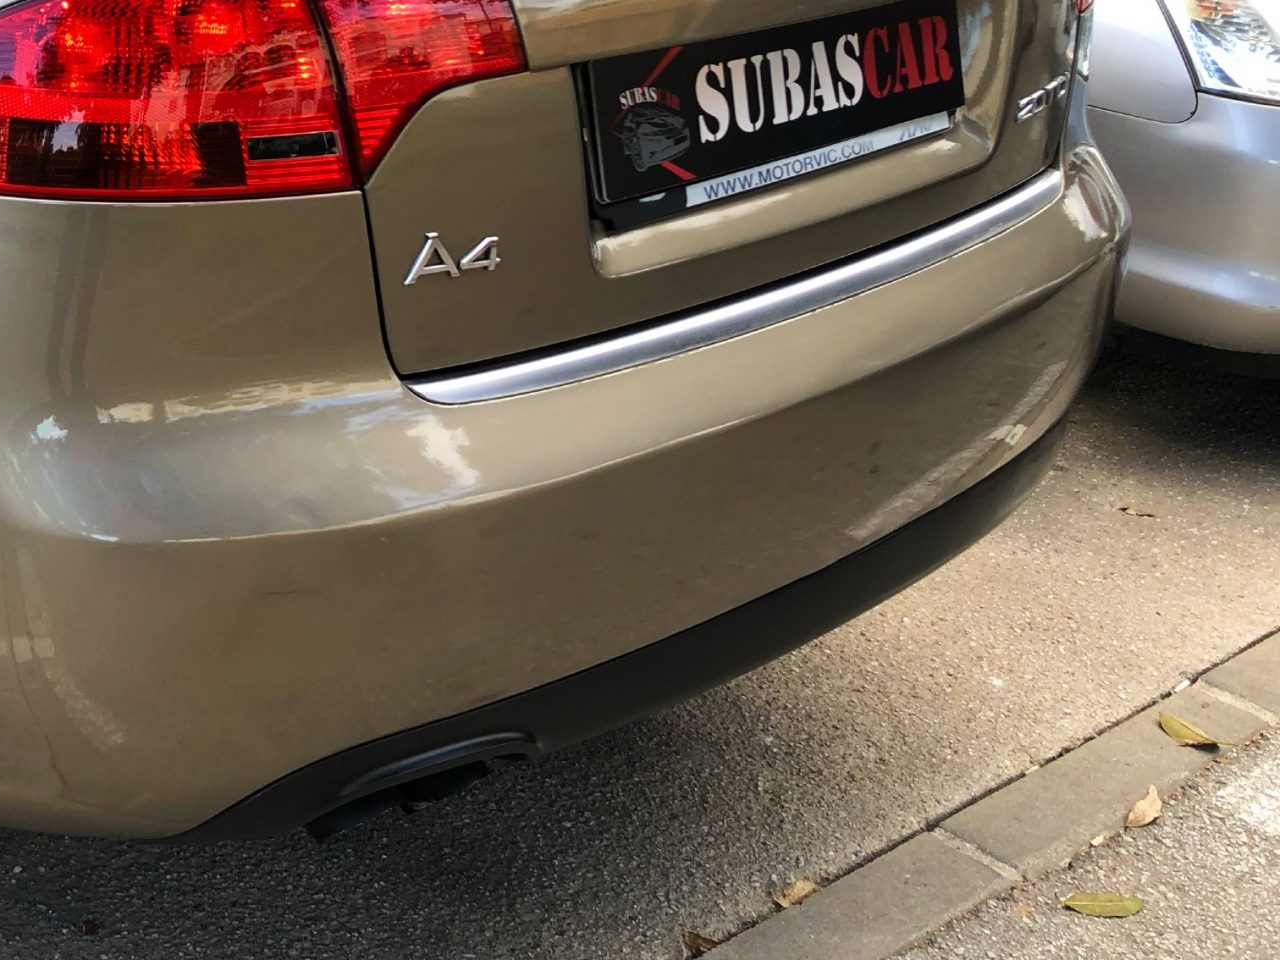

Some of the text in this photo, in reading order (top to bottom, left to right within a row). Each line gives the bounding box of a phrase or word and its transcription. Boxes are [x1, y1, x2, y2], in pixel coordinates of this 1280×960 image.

[695, 14, 955, 144] SUBASCAR
[702, 139, 875, 200] WWW.MOTORVIC.COM
[403, 230, 502, 286] A4
